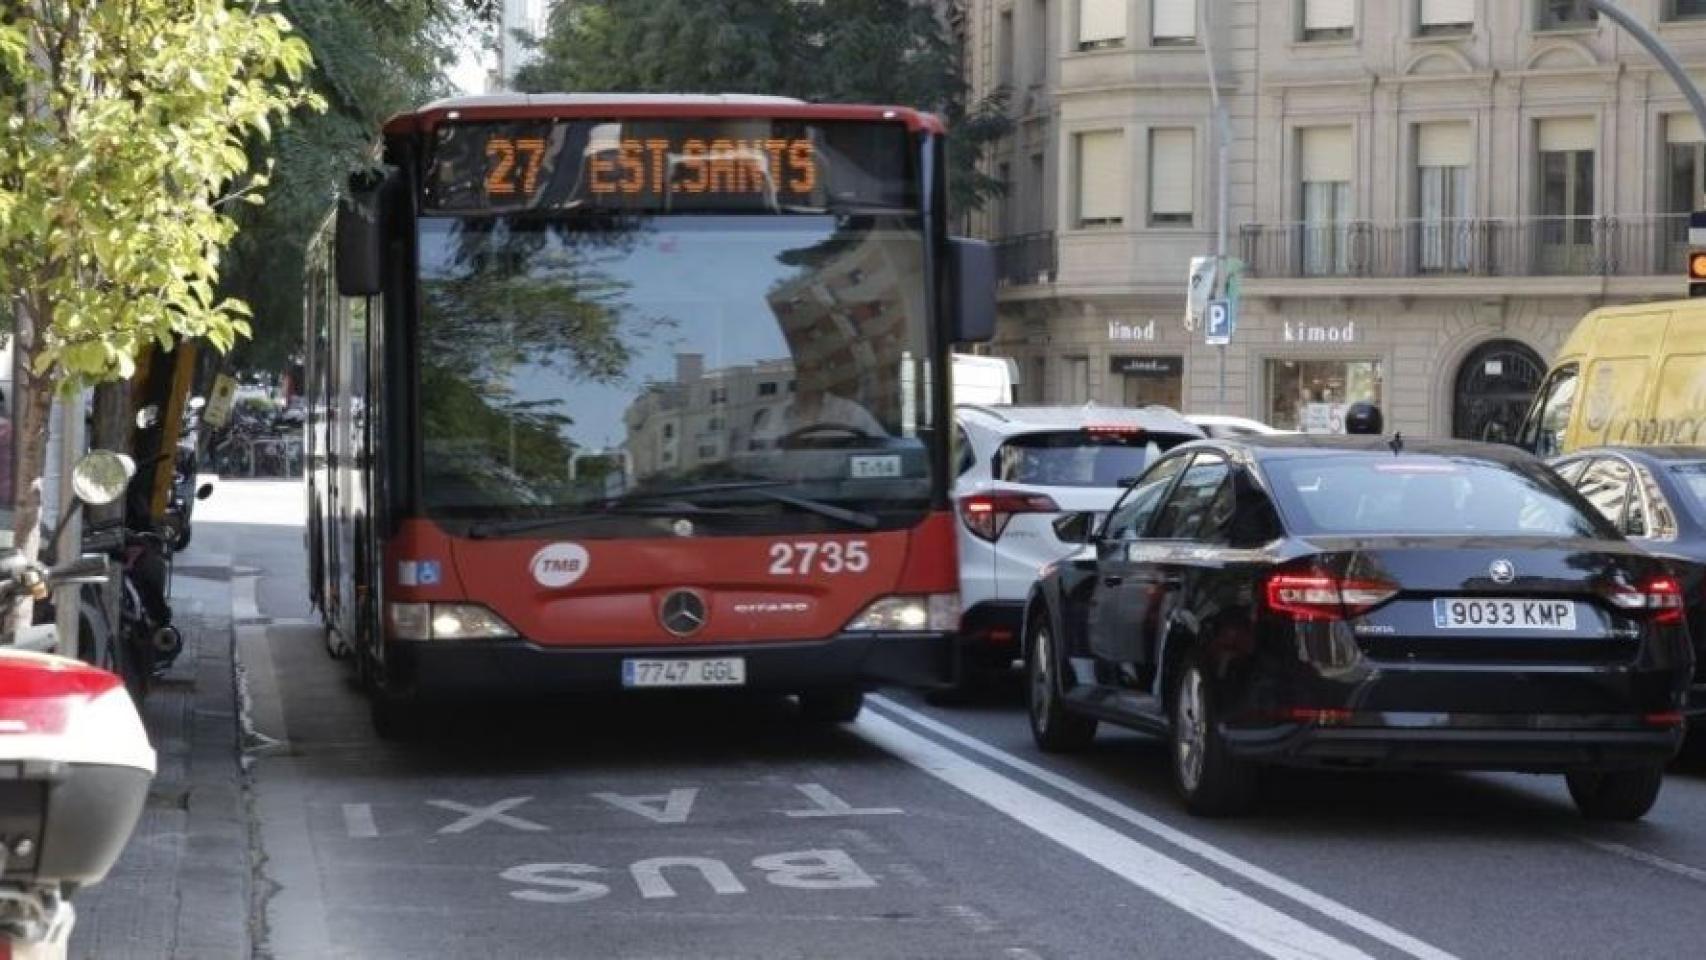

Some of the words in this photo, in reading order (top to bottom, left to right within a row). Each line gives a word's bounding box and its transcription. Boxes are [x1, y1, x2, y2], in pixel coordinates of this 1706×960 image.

[485, 139, 545, 192] 27
[591, 139, 816, 192] EST.SANTS
[1210, 304, 1226, 334] P
[1284, 320, 1353, 341] kimod
[543, 558, 581, 573] TMB
[769, 540, 869, 575] 2735
[1452, 602, 1515, 625] 9033
[1523, 603, 1569, 626] KMP
[638, 661, 689, 682] 7747
[702, 661, 739, 681] GGL
[342, 783, 903, 837] TAXI
[500, 848, 878, 901] BUS
